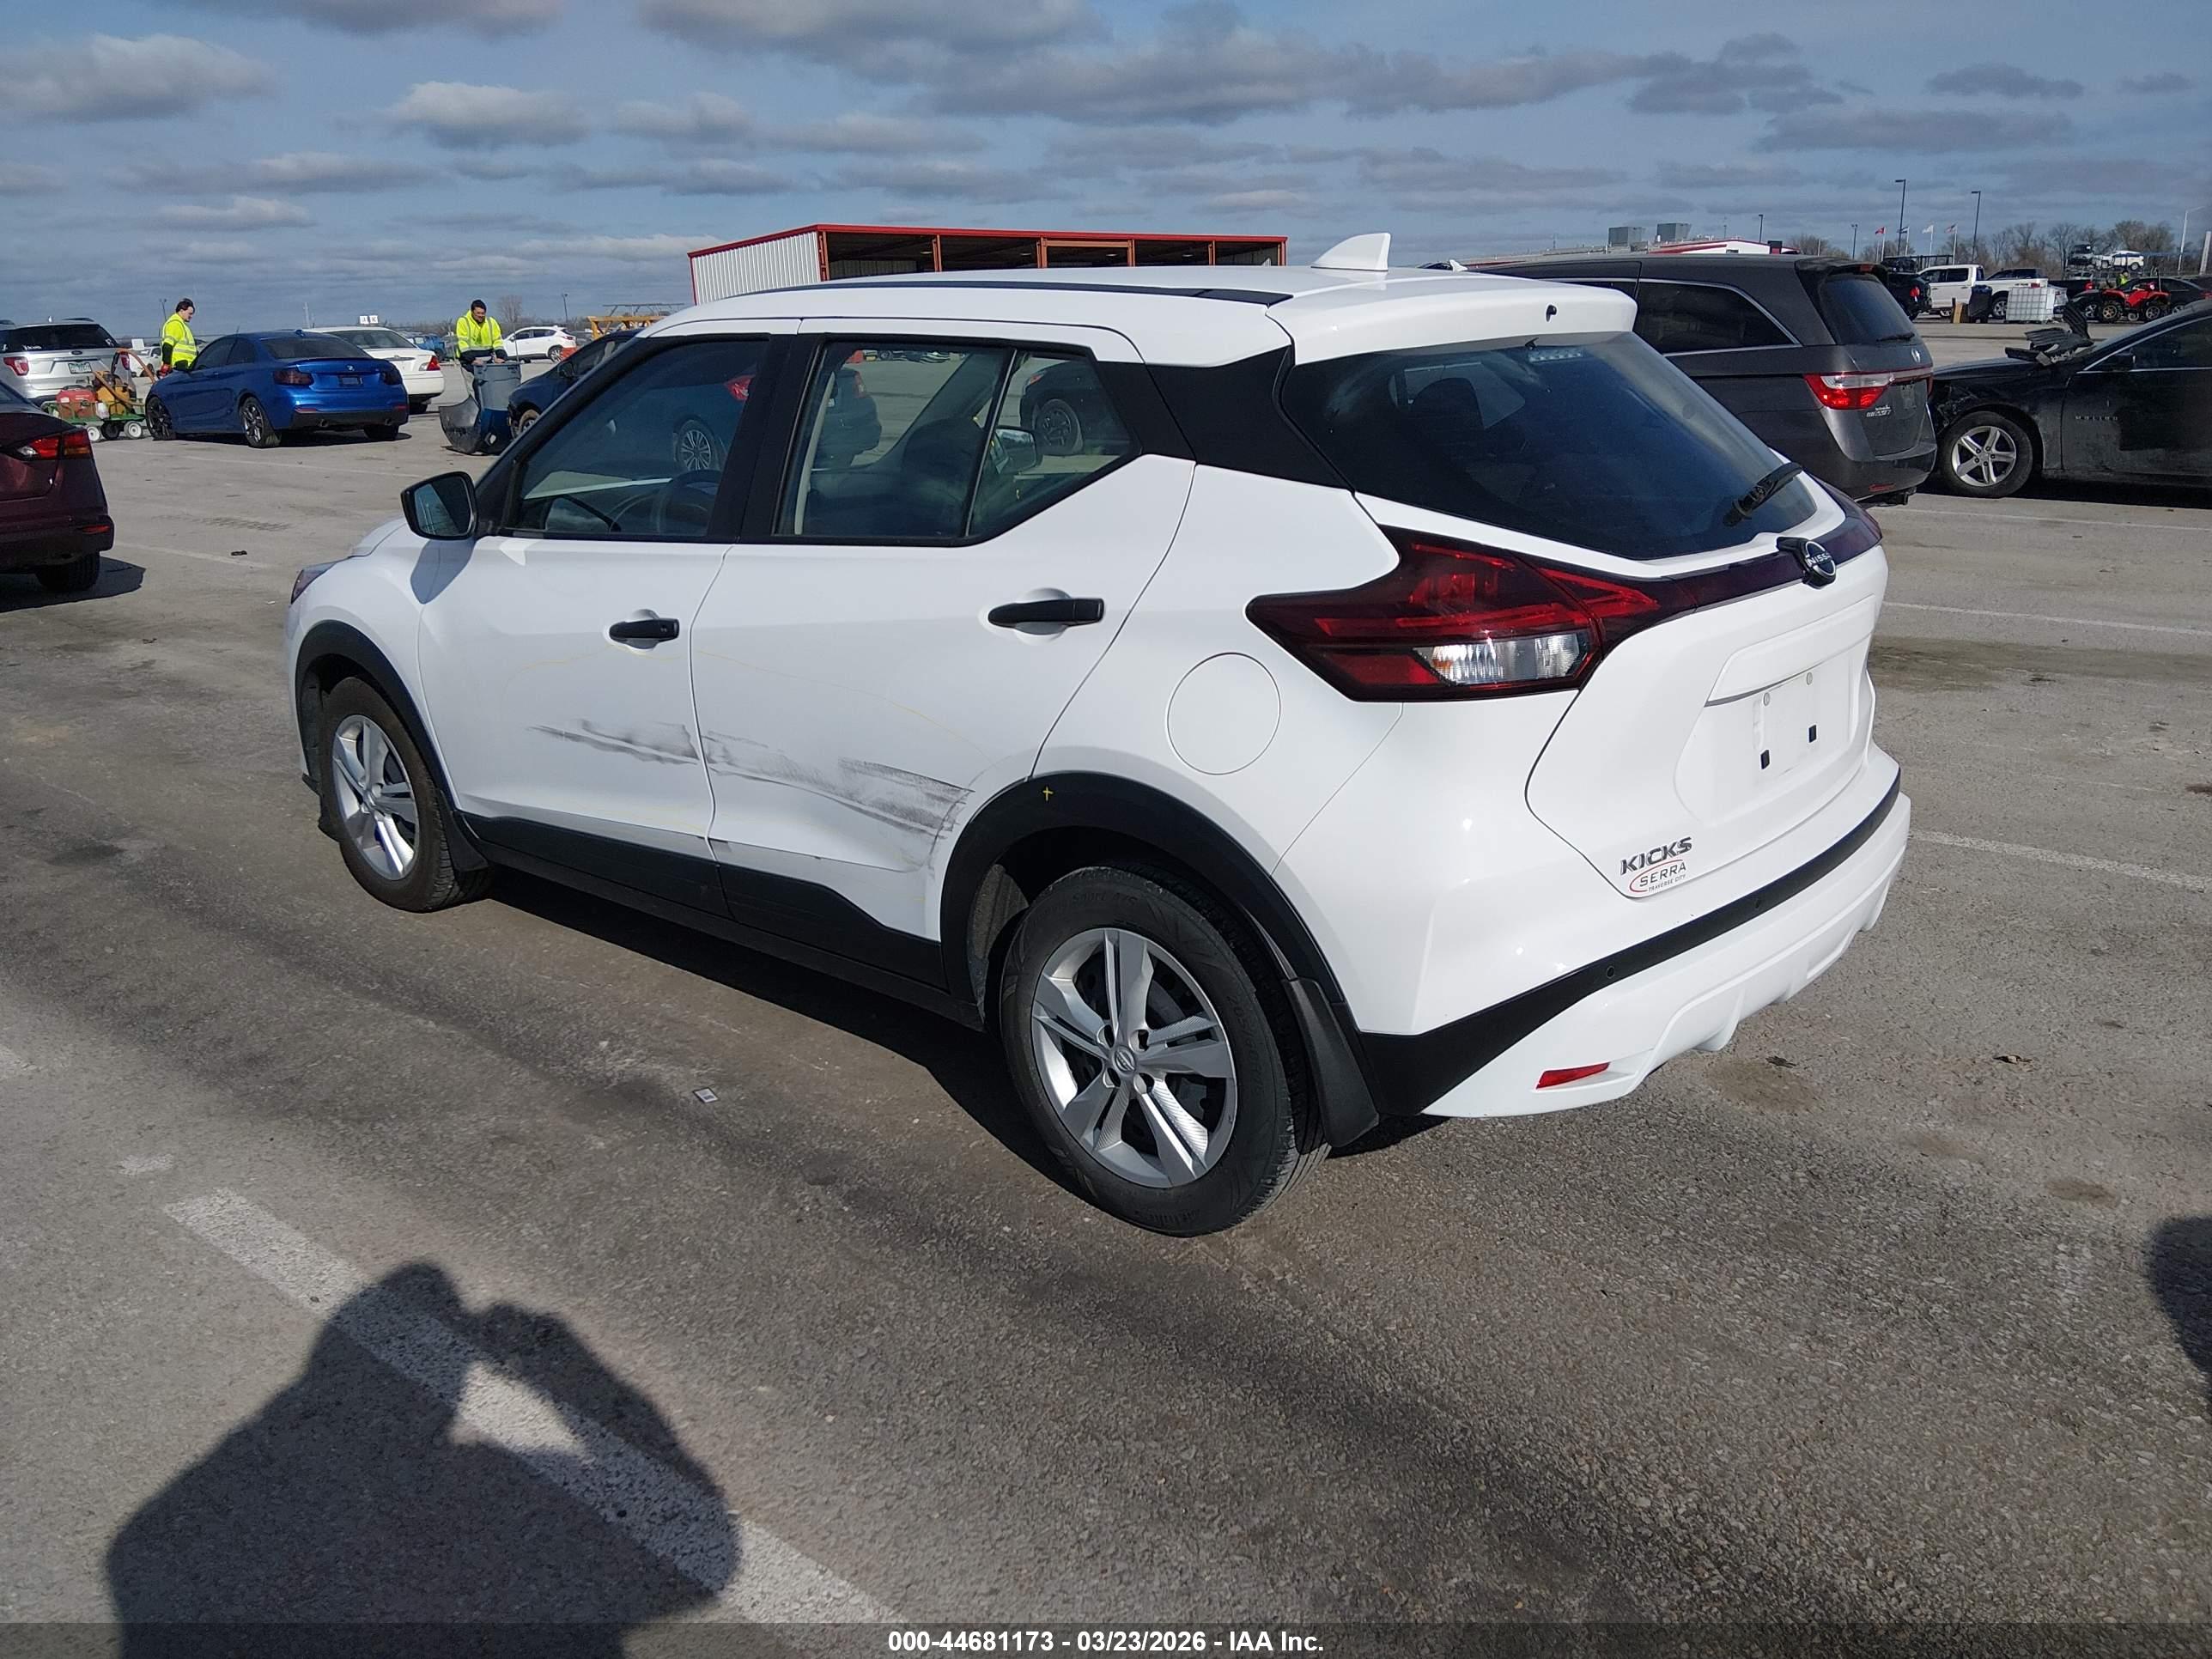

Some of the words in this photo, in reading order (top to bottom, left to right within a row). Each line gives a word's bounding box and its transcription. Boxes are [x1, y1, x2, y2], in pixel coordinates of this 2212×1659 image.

[1620, 836, 1692, 875] KICKS
[1639, 862, 1686, 887] SERRA
[1649, 878, 1674, 892] TRAVERSE
[1674, 874, 1686, 883] CITY
